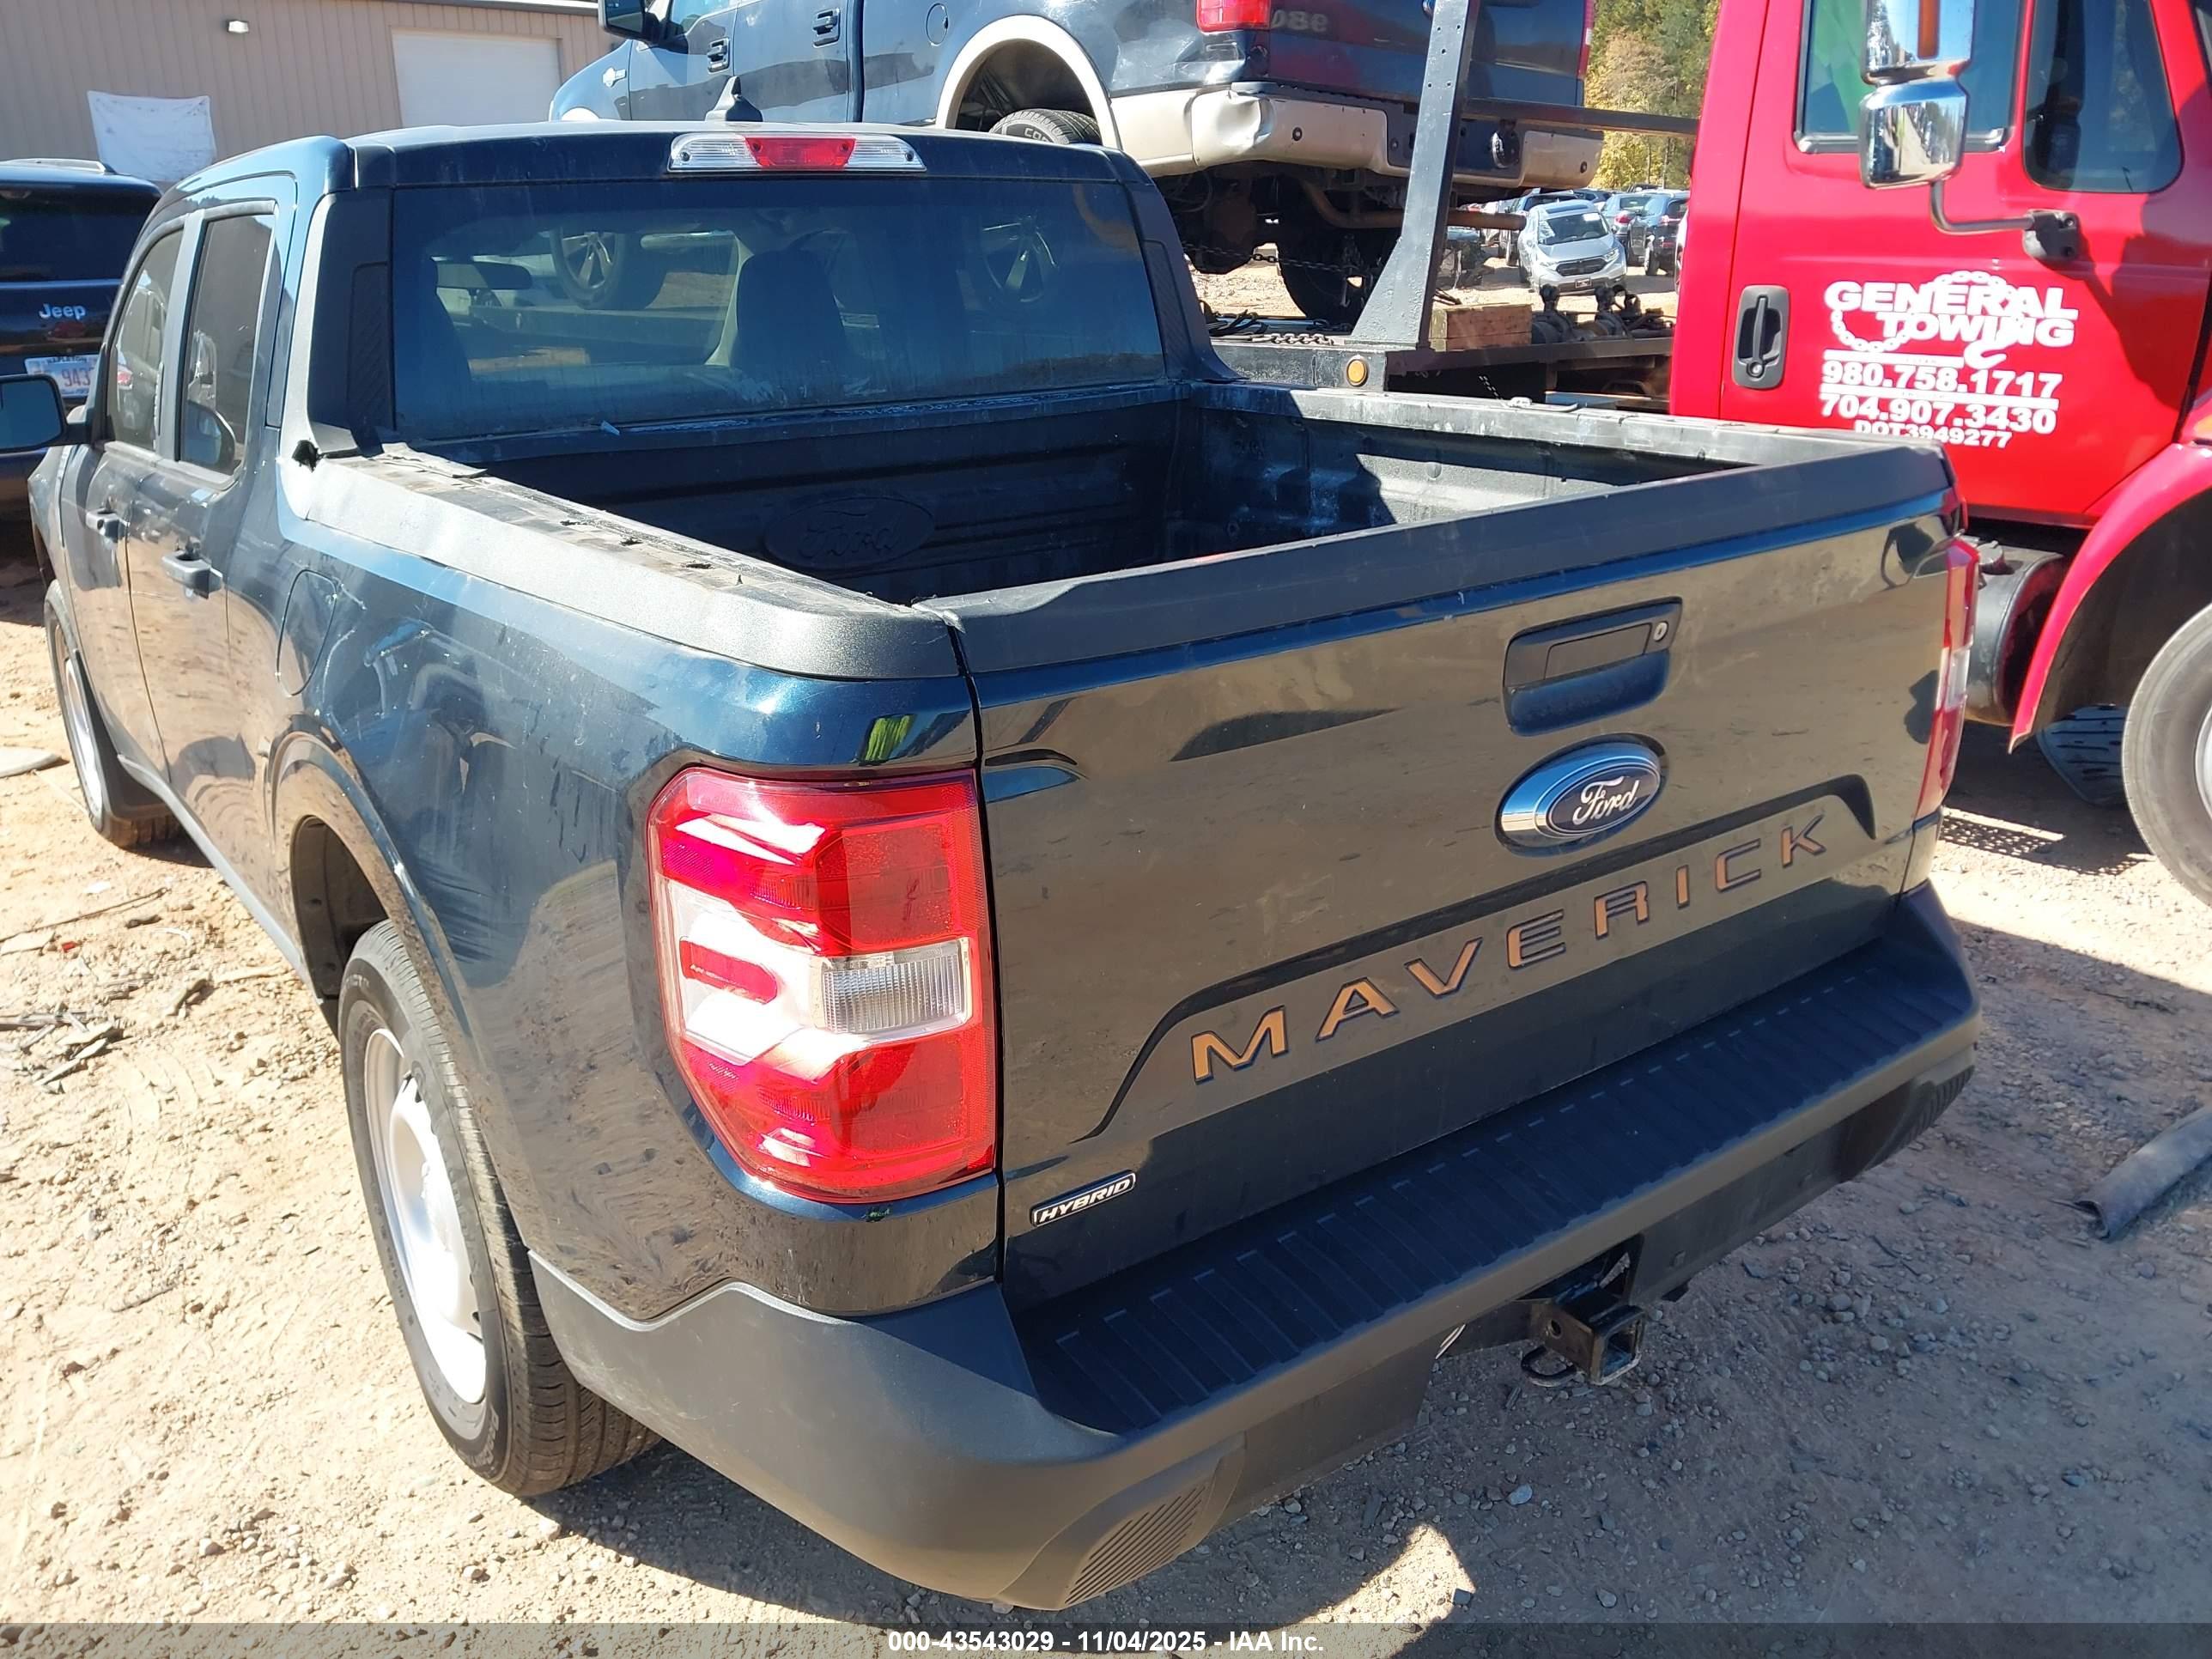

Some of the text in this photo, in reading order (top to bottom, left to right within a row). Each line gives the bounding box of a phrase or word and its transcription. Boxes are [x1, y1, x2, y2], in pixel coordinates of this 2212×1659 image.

[39, 303, 86, 320] Jeep
[1824, 281, 2079, 320] GENERAL
[1875, 311, 2075, 348] TOWING
[1821, 361, 2063, 398] 980.758.1717
[1820, 392, 2057, 434] 704.907.3430
[1854, 419, 2013, 448] DOT3949277
[1571, 775, 1640, 826] Ford
[1190, 814, 1826, 1084] MAVERICK
[1038, 1178, 1132, 1224] HYBRID
